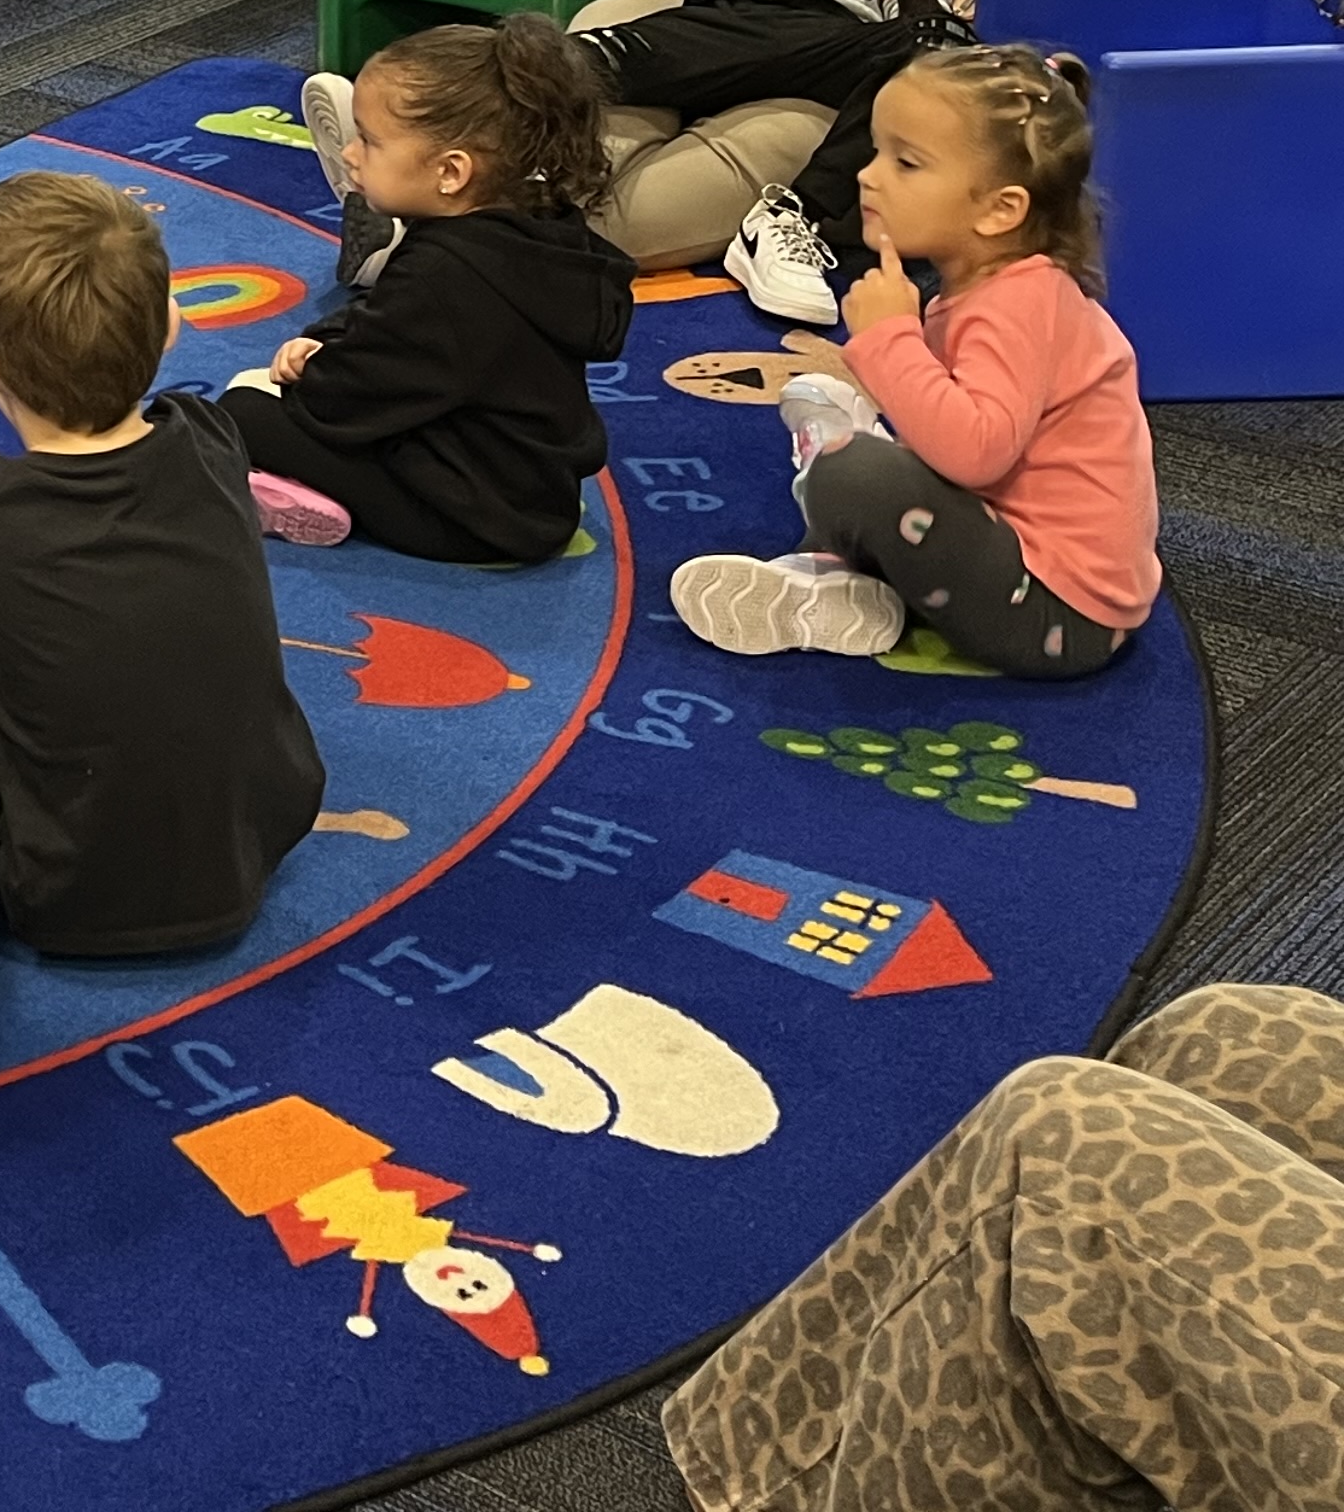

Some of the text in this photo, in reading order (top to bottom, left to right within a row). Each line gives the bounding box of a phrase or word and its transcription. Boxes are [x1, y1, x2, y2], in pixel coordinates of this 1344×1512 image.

[128, 135, 230, 172] Aa
[621, 457, 725, 513] Ee
[589, 688, 734, 750] Gg
[496, 805, 659, 883] Hh
[337, 935, 495, 1006] Ii
[105, 1039, 259, 1116] Jj
